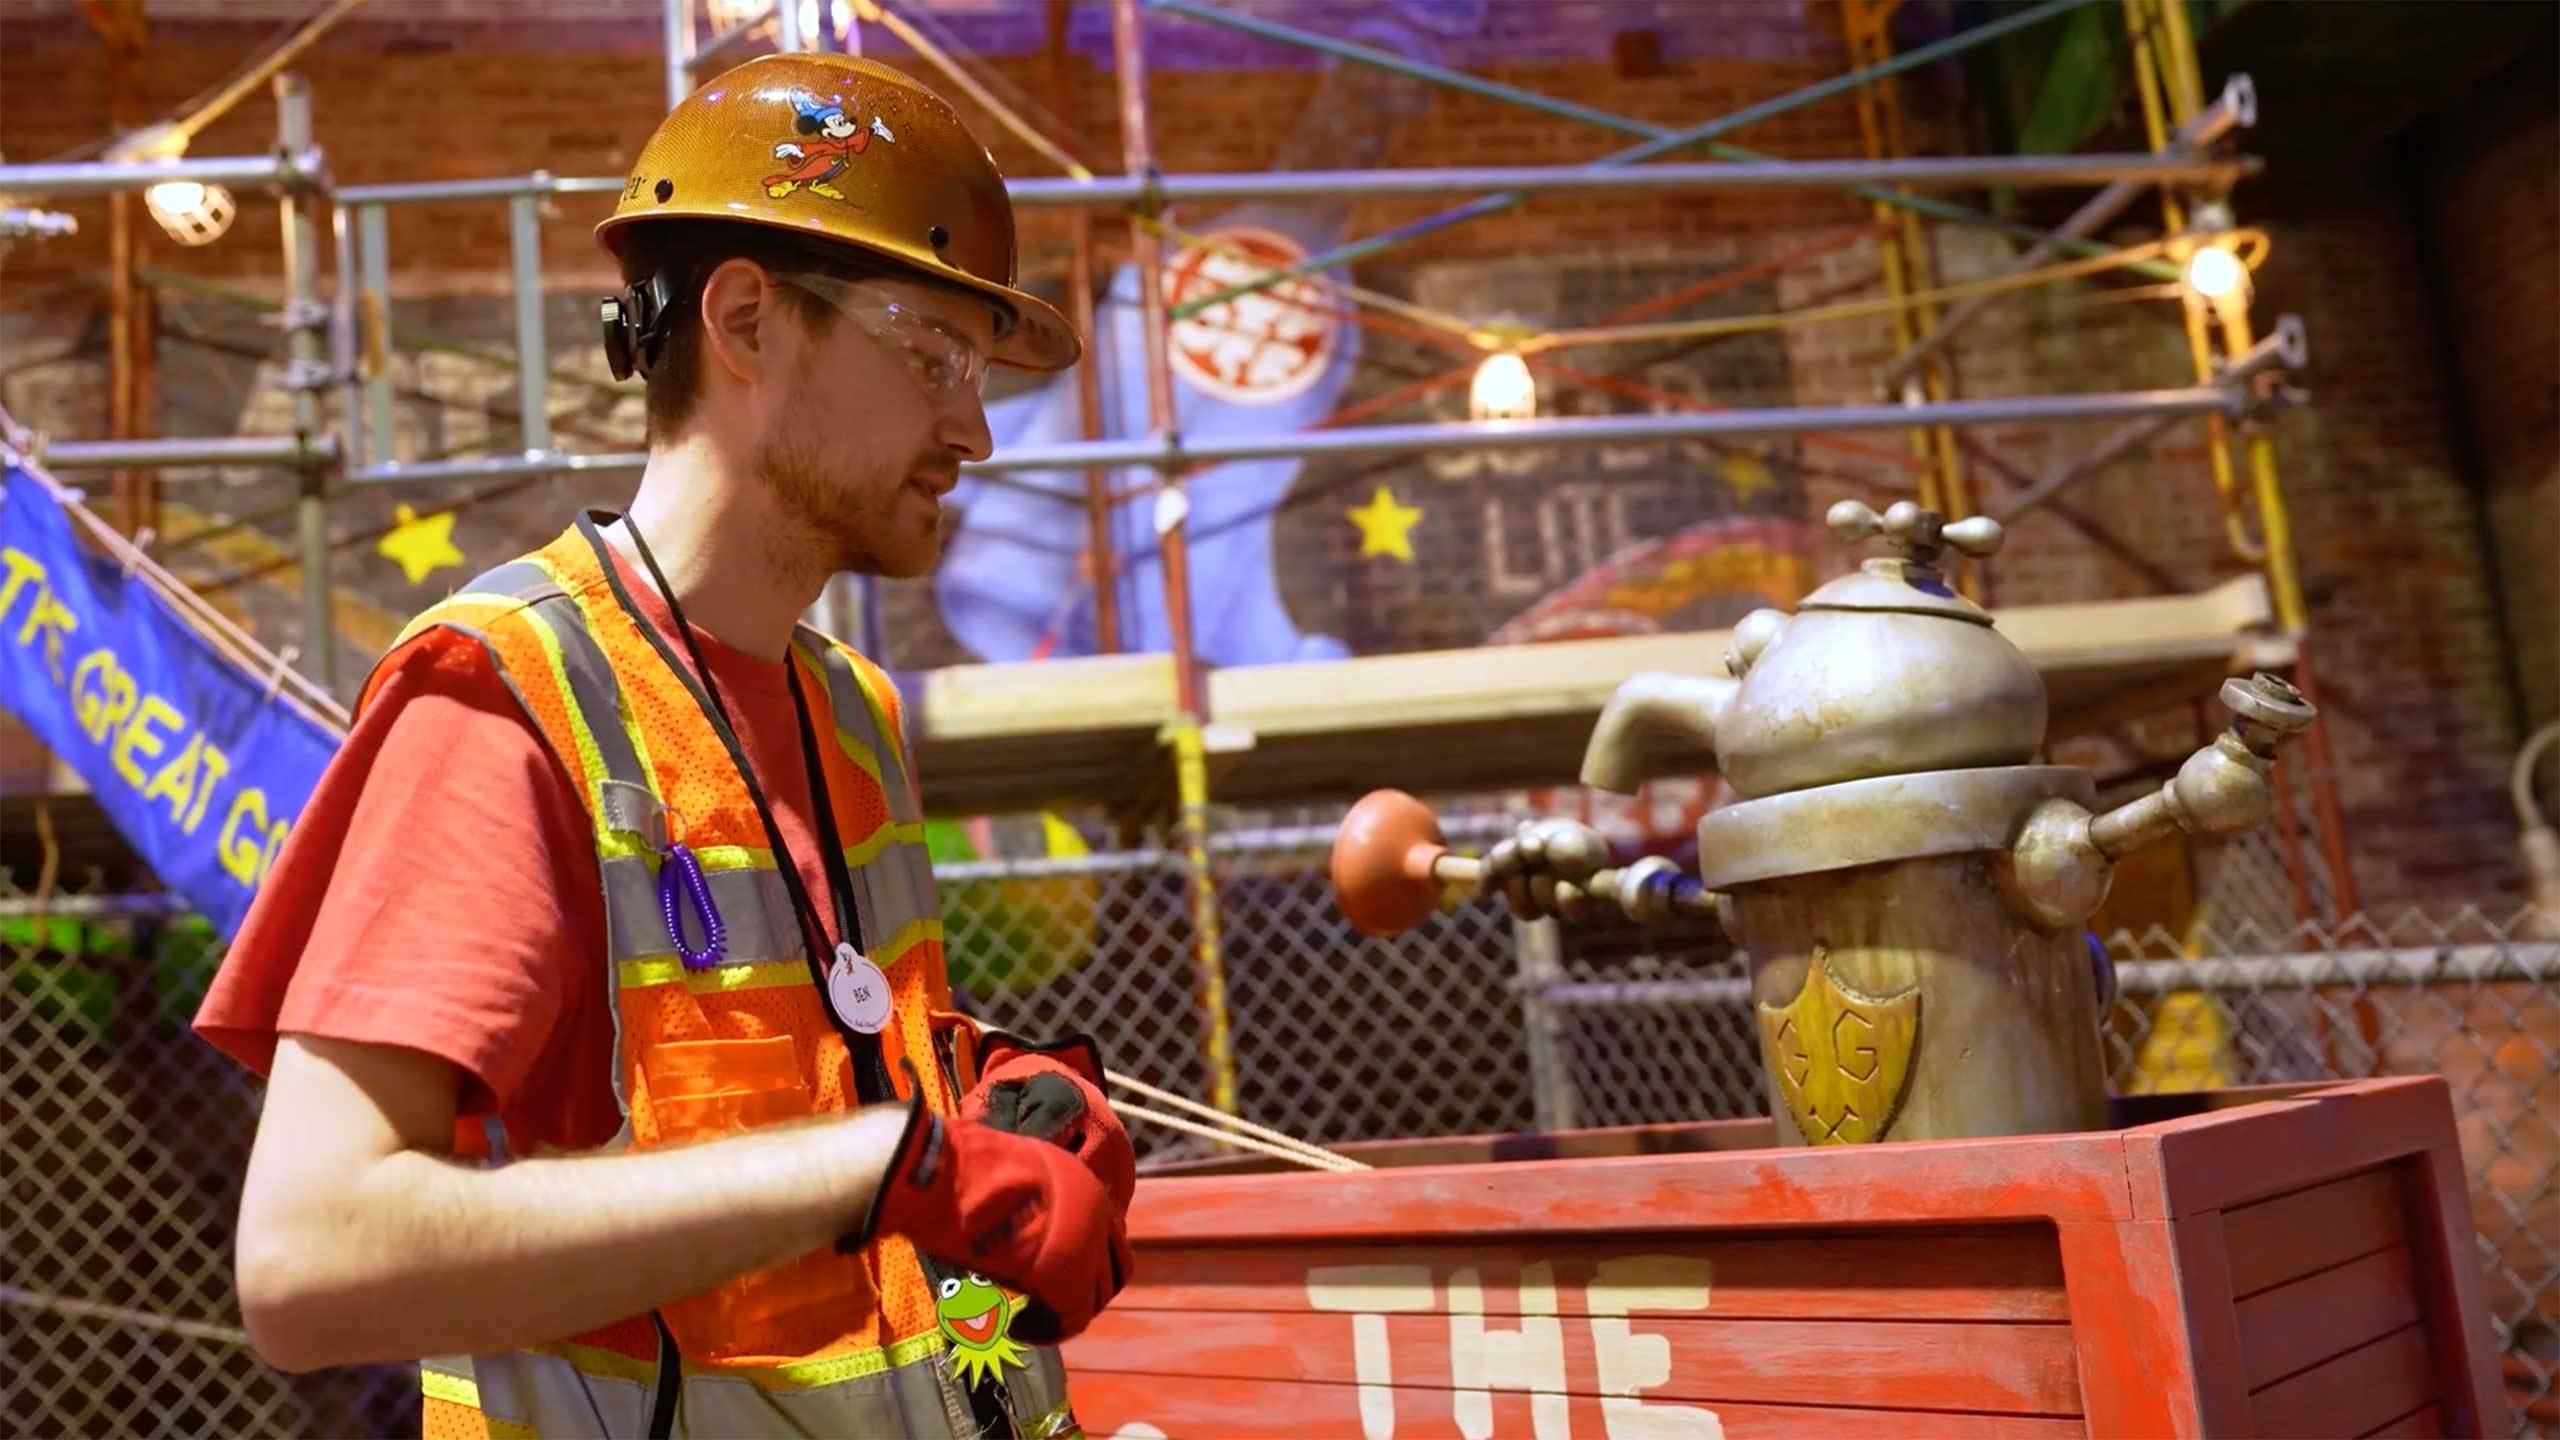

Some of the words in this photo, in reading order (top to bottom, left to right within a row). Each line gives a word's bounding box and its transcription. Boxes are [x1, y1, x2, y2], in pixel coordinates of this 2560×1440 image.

[72, 649, 230, 835] GREAT
[852, 986, 872, 1004] BEN
[1306, 1255, 1724, 1440] THE
